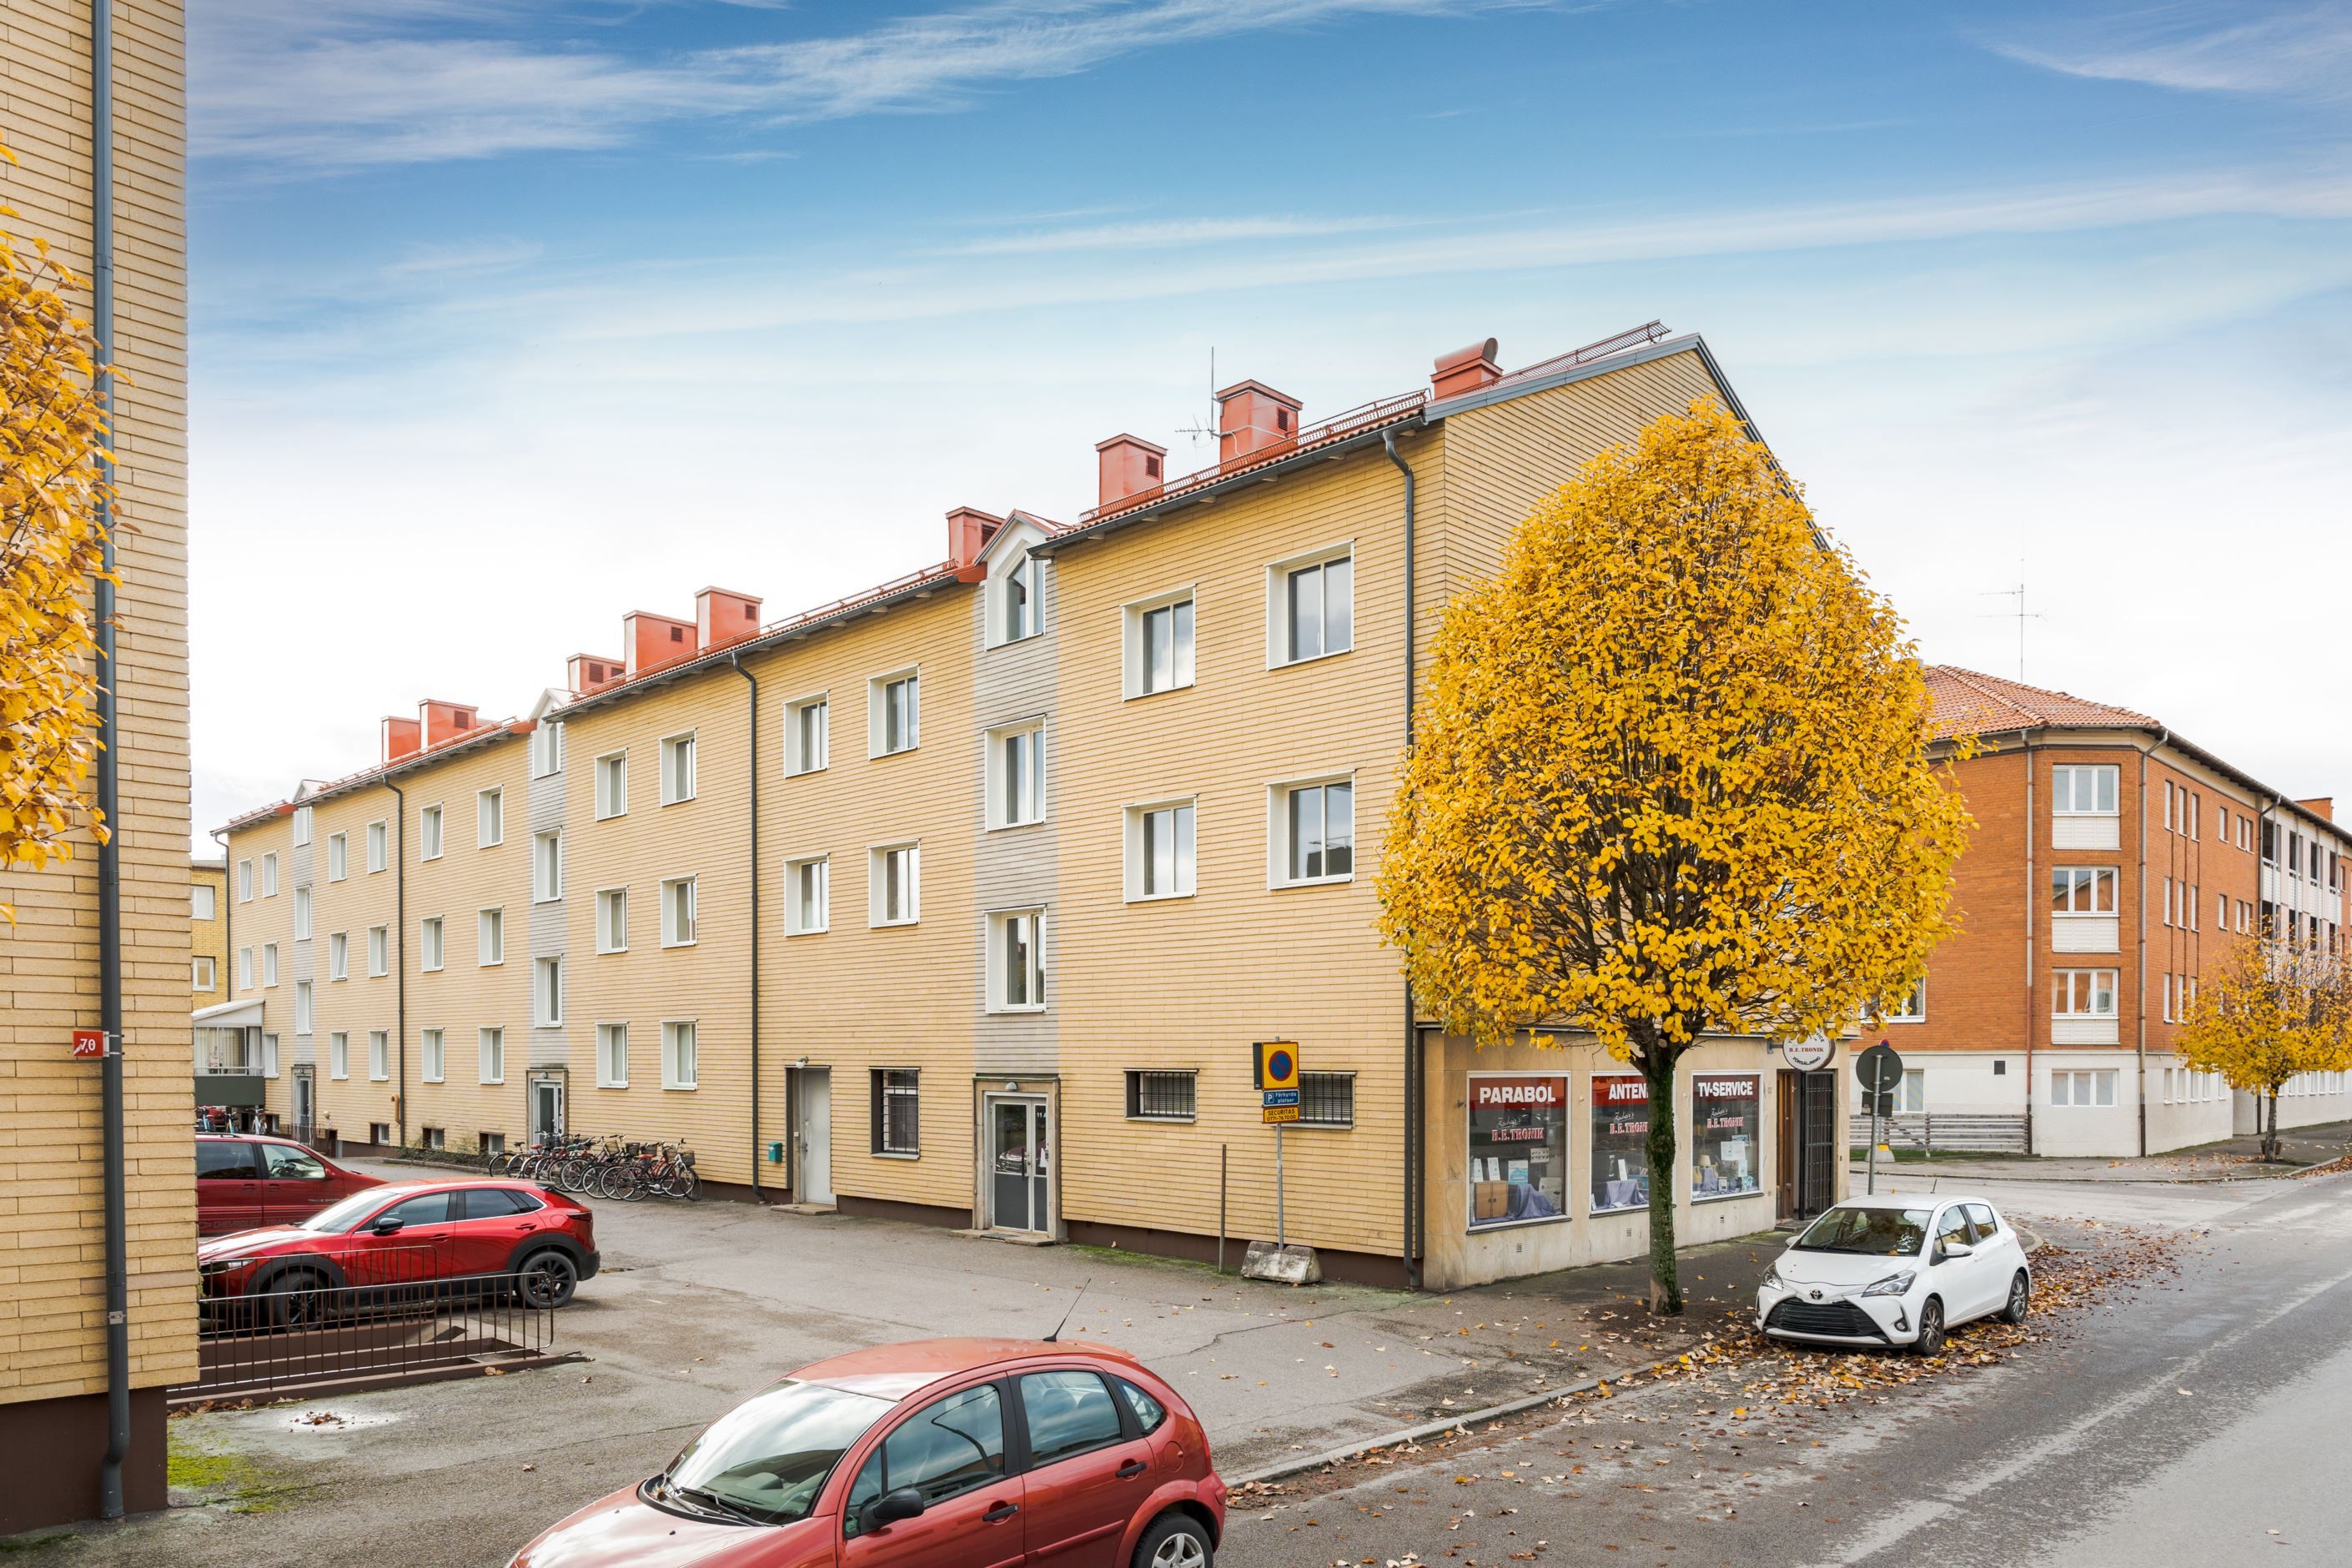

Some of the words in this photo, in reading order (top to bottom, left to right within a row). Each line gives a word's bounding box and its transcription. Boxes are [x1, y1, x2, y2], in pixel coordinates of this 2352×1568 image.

[1480, 1085, 1556, 1103] PARABOL
[1608, 1083, 1649, 1100] ANTEN
[1697, 1081, 1753, 1097] TV-SERVICE
